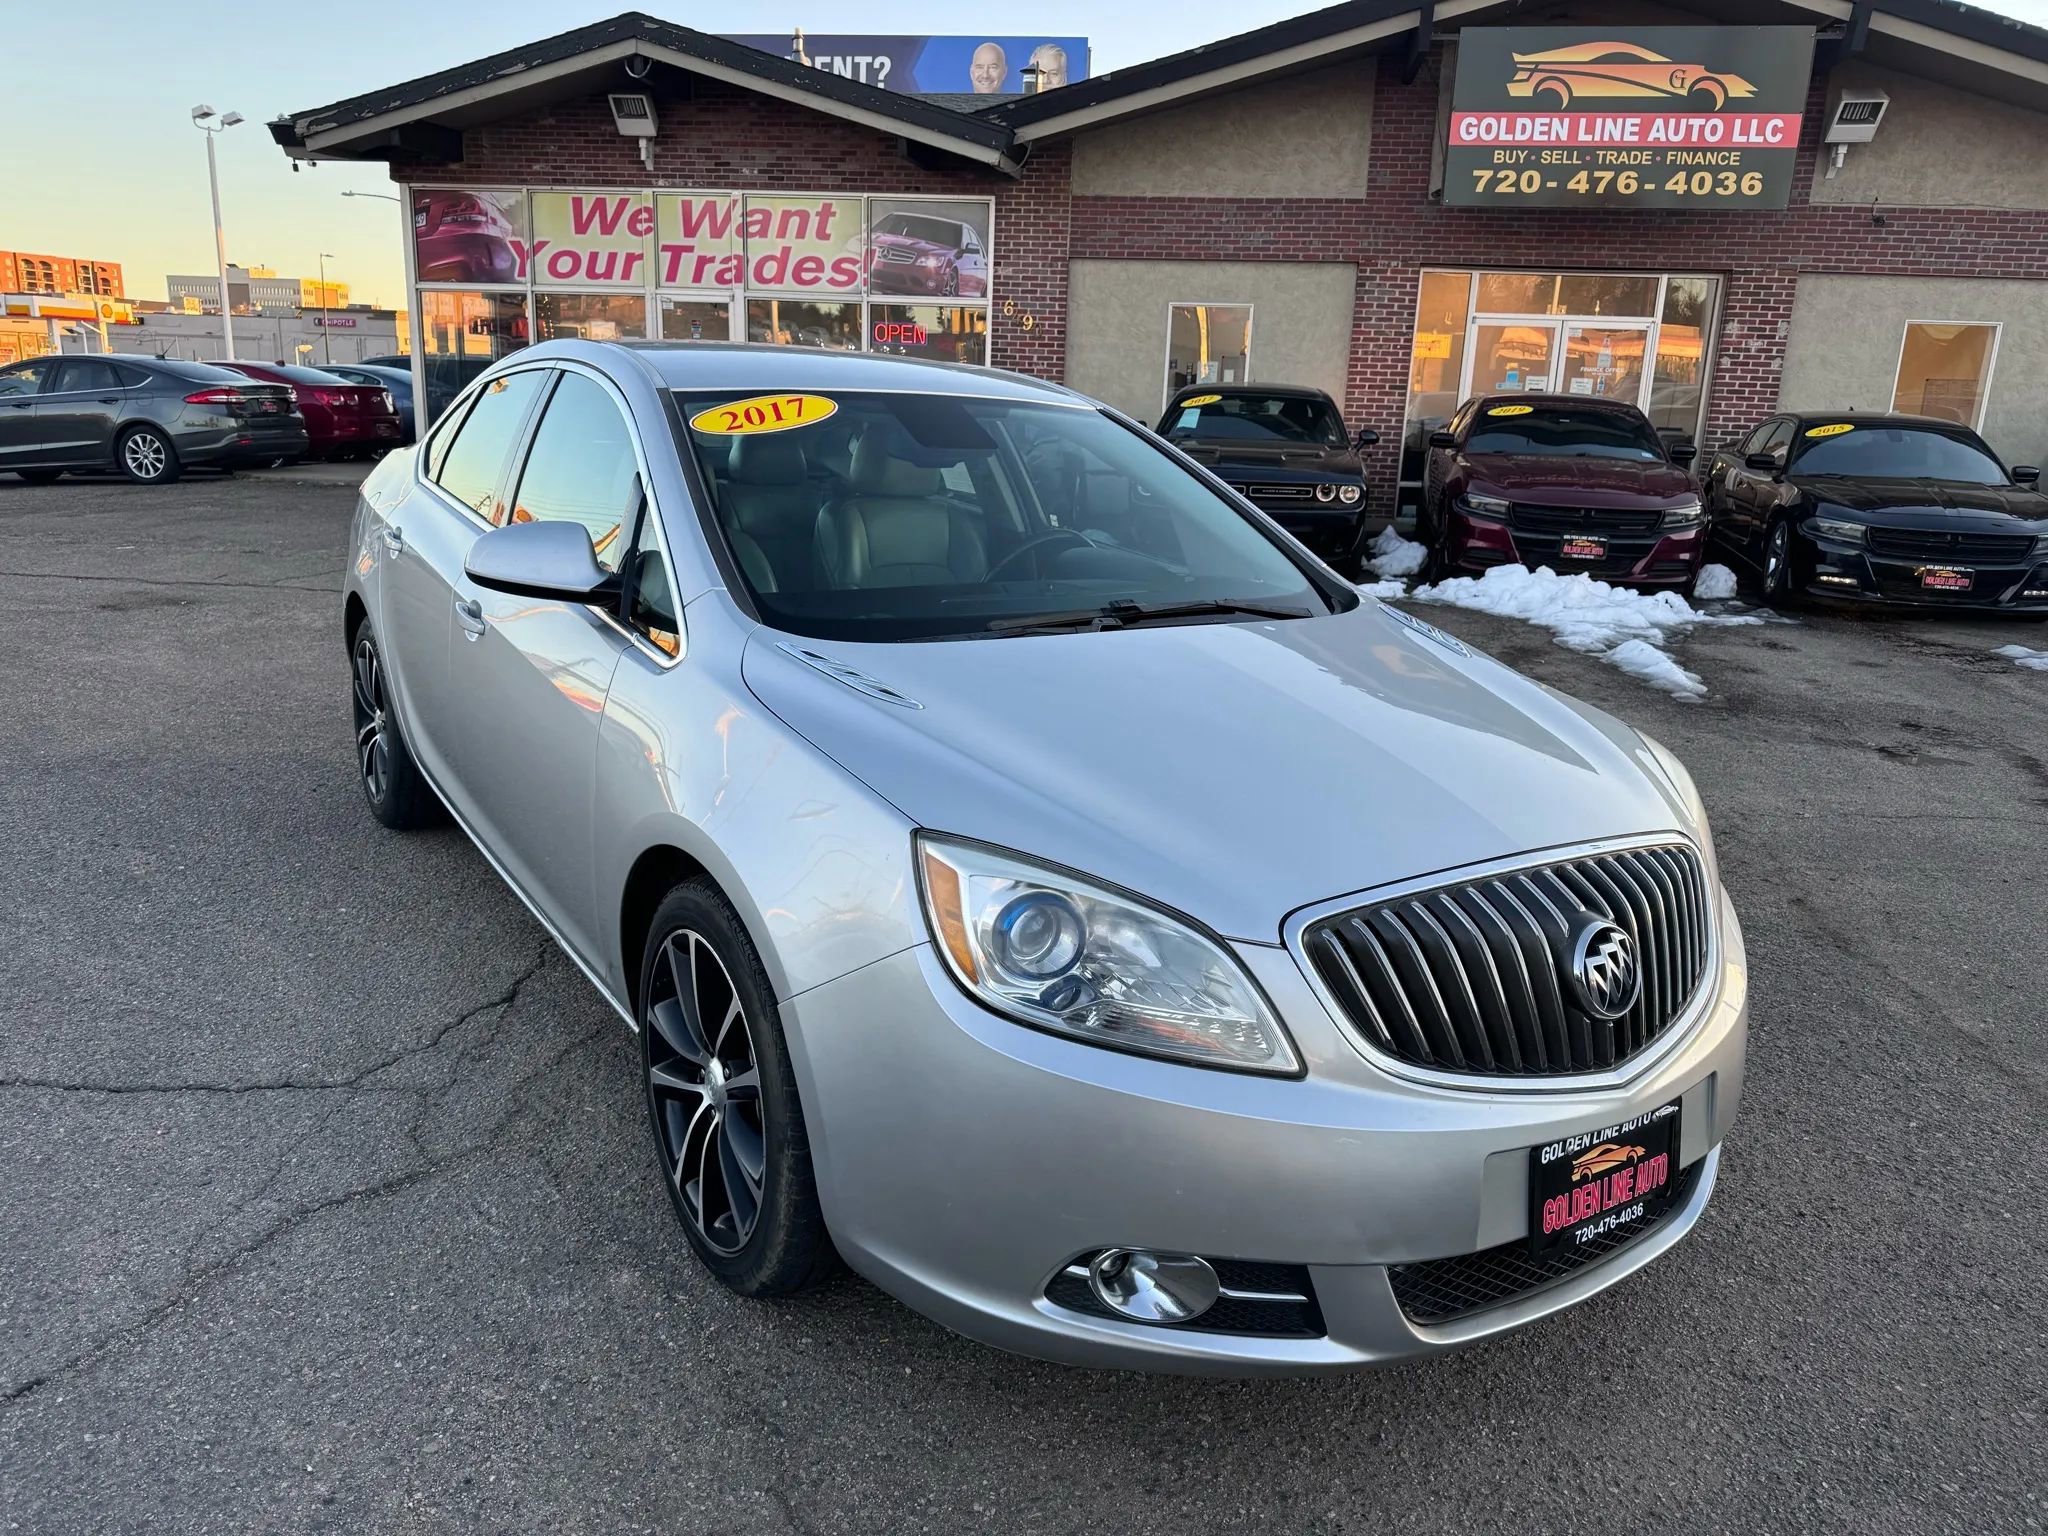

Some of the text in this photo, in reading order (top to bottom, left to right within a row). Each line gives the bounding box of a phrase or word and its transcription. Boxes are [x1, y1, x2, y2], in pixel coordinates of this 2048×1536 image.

[1459, 116, 1784, 144] GOLDEN LINE AUTO LLC
[1493, 150, 1741, 166] BUY SELL TRADE FINANCE
[571, 196, 837, 242] We Want
[508, 240, 877, 288] Your Trades!
[874, 323, 927, 345] OPEN
[720, 397, 804, 431] 2017
[1541, 1111, 1652, 1164] GOLDEN LINE AUTO
[1543, 1153, 1668, 1234] GOLDEN LINE AUTO
[1575, 1202, 1644, 1245] 720-476-4036
